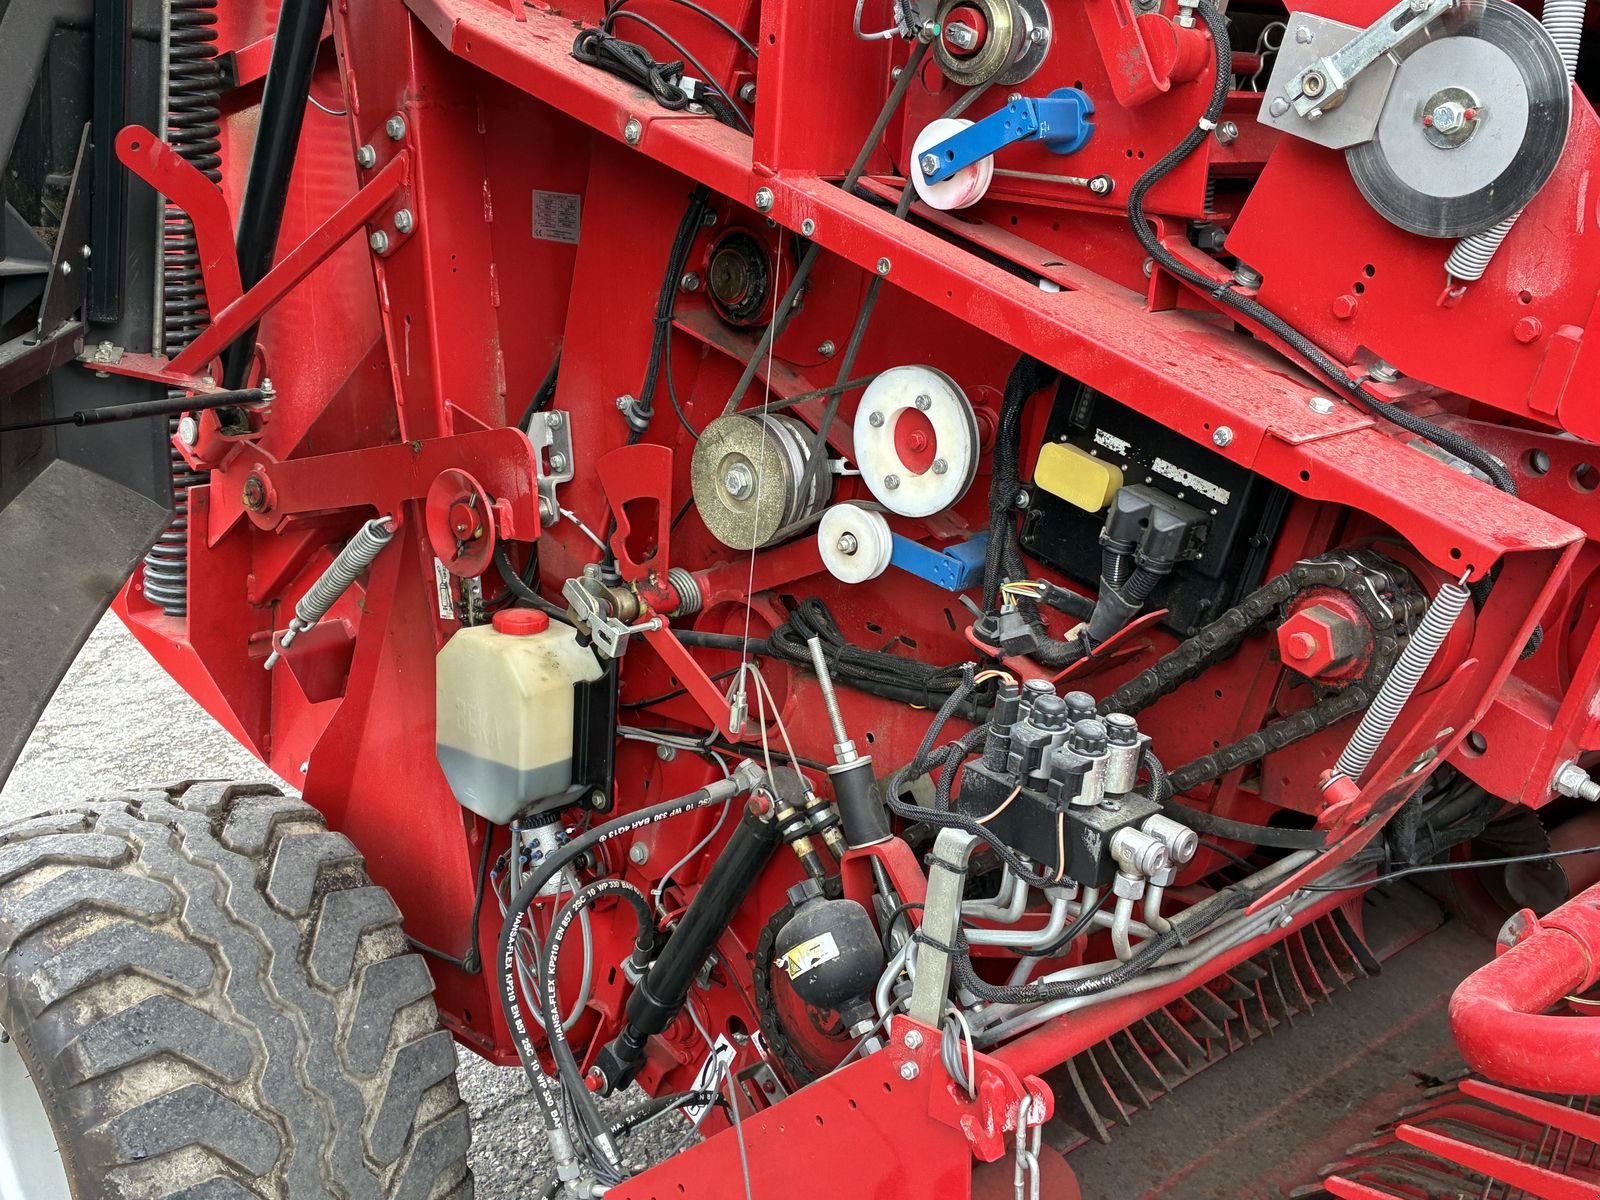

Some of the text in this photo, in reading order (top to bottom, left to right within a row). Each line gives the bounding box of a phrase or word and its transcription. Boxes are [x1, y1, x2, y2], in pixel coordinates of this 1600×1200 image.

[669, 808, 682, 817] WP
[686, 804, 694, 812] 10
[632, 817, 650, 829] BAR
[654, 811, 668, 822] 330
[596, 882, 608, 892] WP
[608, 880, 620, 889] 330
[587, 888, 596, 897] 10
[572, 895, 586, 912] 2SC
[561, 910, 573, 927] 857
[504, 911, 525, 970] HANSA-FLEX
[555, 926, 565, 941] EN
[548, 944, 560, 974] KP210
[505, 973, 516, 1002] KP210
[510, 1004, 520, 1019] EN
[547, 979, 565, 1042] HANSA-FLEX
[515, 1019, 526, 1034] 857
[521, 1038, 534, 1057] 2SC
[530, 1059, 540, 1071] 10
[536, 1073, 548, 1089] WP
[542, 1090, 554, 1107] 330
